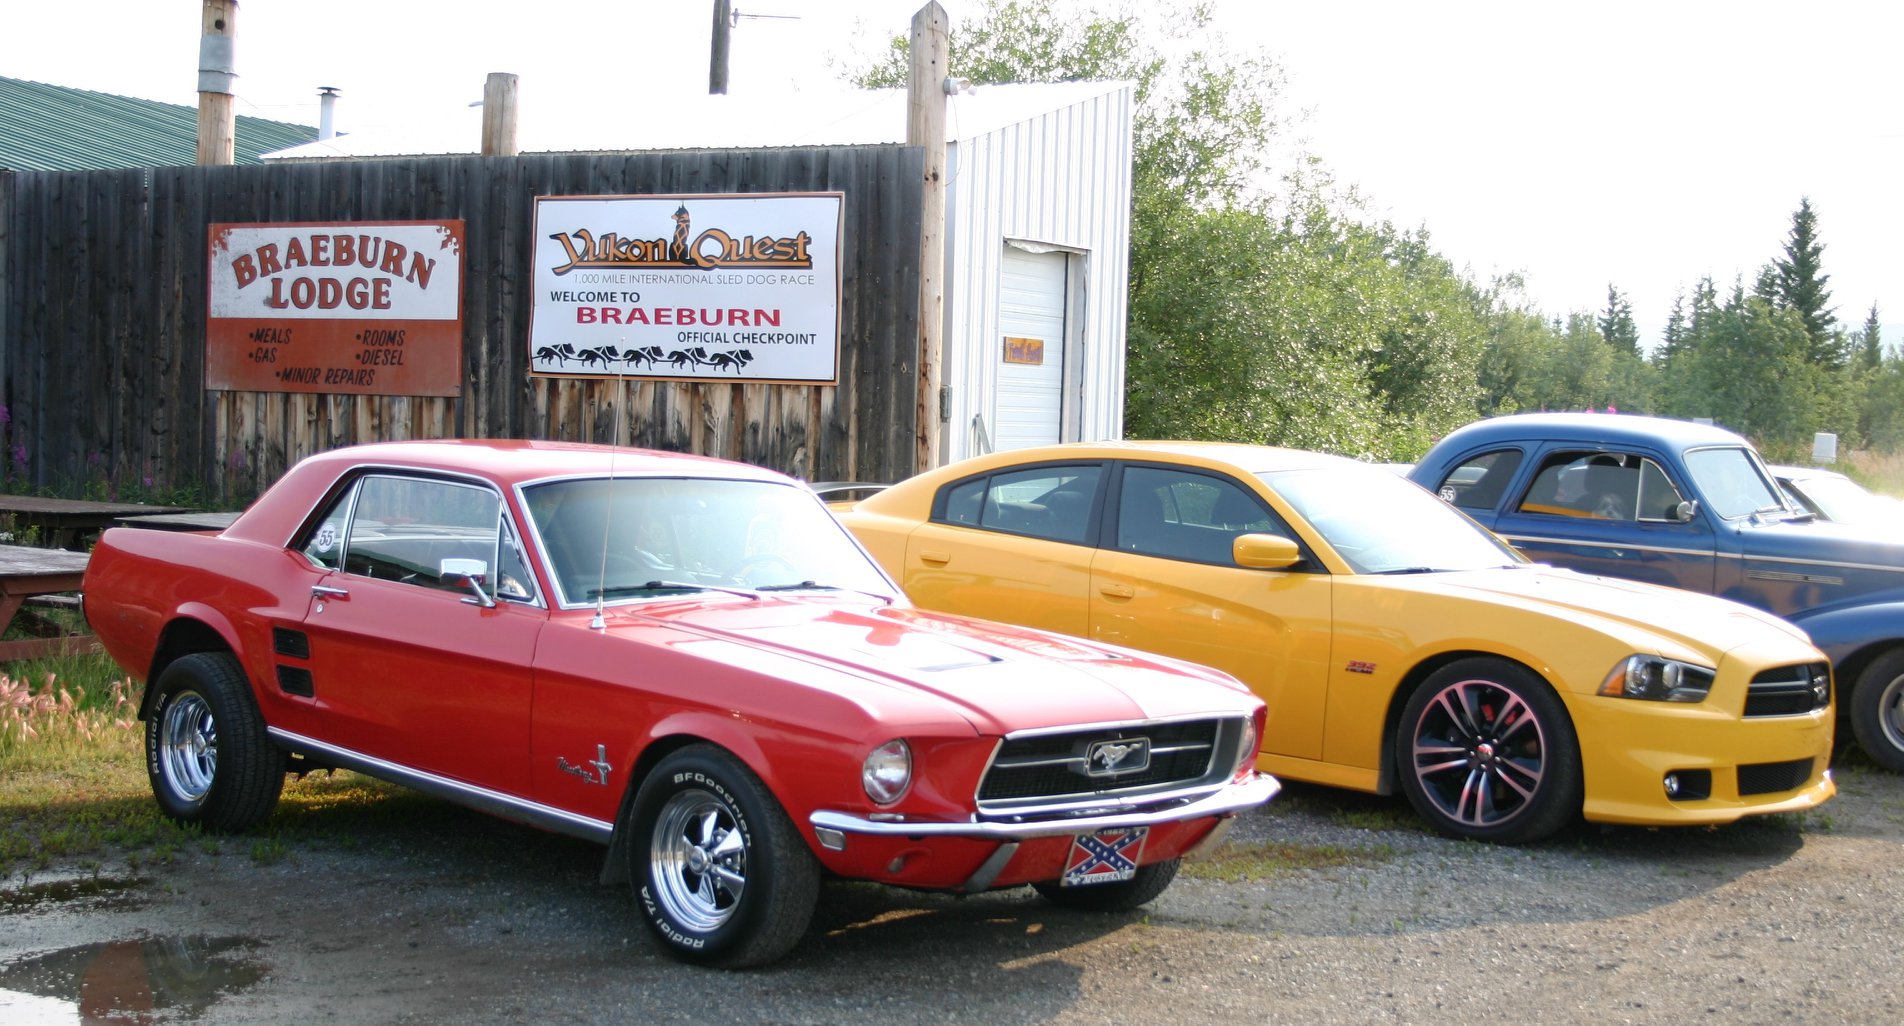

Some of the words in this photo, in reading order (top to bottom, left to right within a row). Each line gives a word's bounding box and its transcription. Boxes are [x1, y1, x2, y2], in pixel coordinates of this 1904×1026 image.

[549, 228, 669, 276] Yukon
[689, 228, 812, 270] Quest
[231, 234, 436, 290] BRAEBURN
[602, 273, 627, 285] MILE
[629, 273, 714, 286] INTERNATIONAL
[717, 274, 743, 285] SLED
[746, 274, 777, 285] DOG
[780, 274, 815, 285] RACE
[271, 276, 392, 310] LODGE
[550, 291, 617, 303] WELCOME
[621, 291, 641, 303] TO
[576, 306, 781, 327] BRAEBURN
[254, 328, 292, 344] MEALS
[362, 330, 406, 347] ROOMS
[677, 331, 730, 344] OFFICIAL
[733, 332, 817, 345] CHECKPOINT
[254, 347, 278, 363] GAS
[361, 349, 404, 366] DIESEL
[281, 367, 321, 384] MINOR
[324, 368, 376, 386] REPAIRS
[1440, 489, 1454, 500] 55
[319, 530, 334, 546] 55
[641, 885, 657, 916] T/A
[656, 918, 704, 949] Radial
